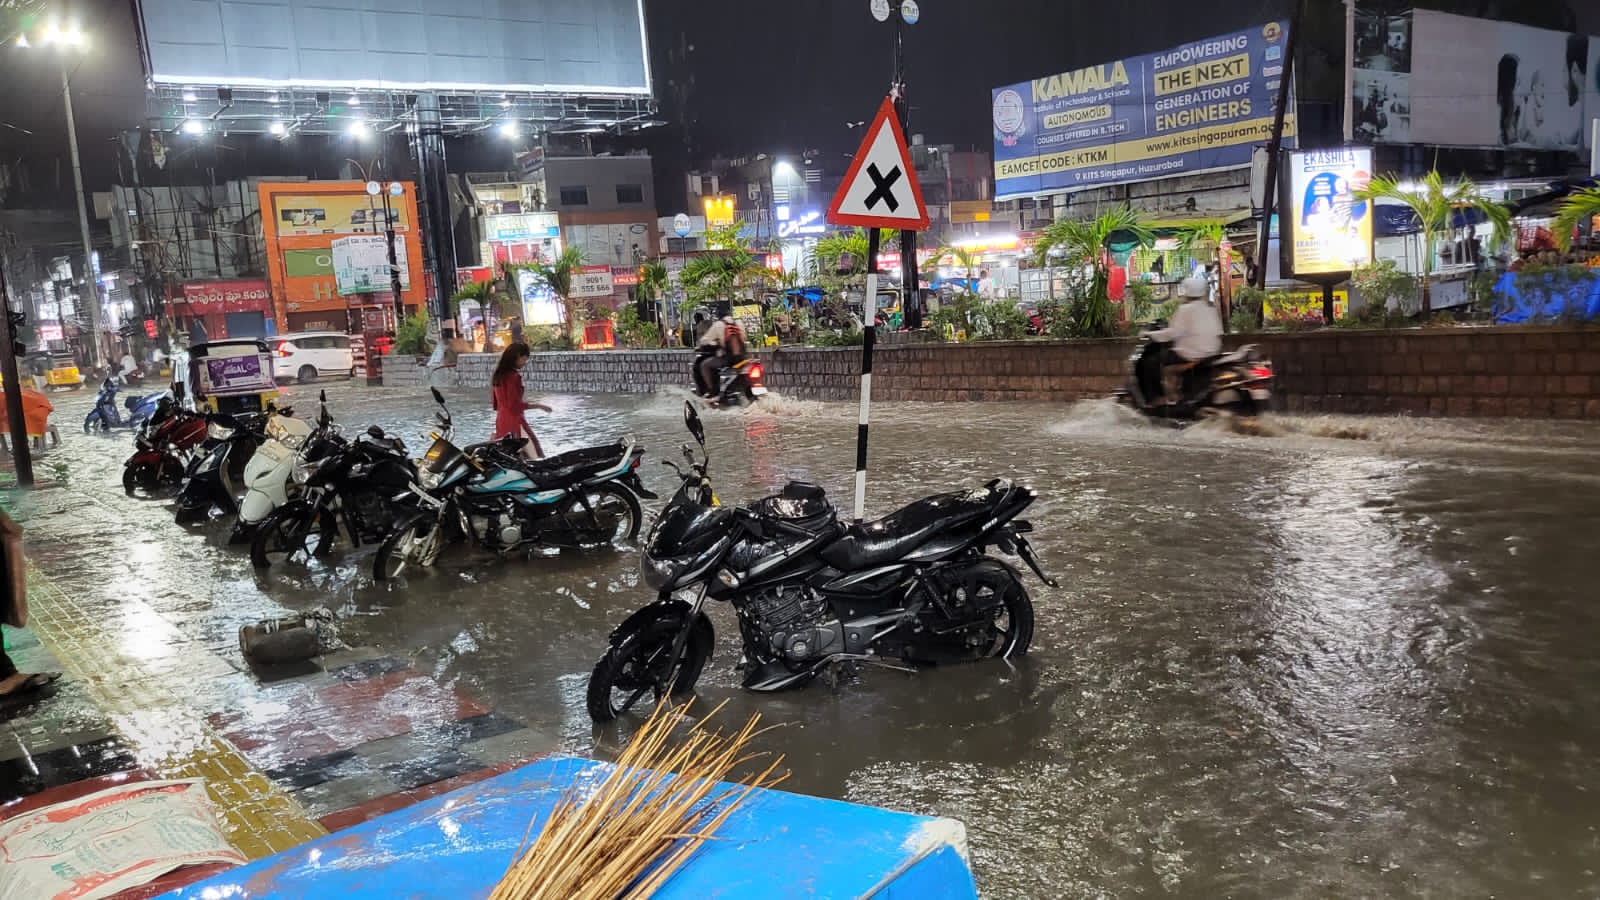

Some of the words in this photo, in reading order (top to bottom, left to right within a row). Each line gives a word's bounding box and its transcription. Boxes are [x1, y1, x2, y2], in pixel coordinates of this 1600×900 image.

[1153, 35, 1248, 69] EMPOWERING
[1031, 60, 1129, 103] KAMALA
[1159, 70, 1192, 91] THE
[1197, 58, 1244, 82] NEXT
[1155, 86, 1230, 111] GENERATION
[1233, 82, 1251, 96] OF
[1048, 106, 1107, 127] AUTONOMOUS
[1155, 98, 1251, 131] ENGINEERS
[1037, 134, 1063, 145] COURSES
[1064, 129, 1091, 142] OFFERED
[1091, 127, 1099, 136] IN
[1108, 122, 1125, 133] TECH
[1002, 160, 1040, 176] EAMCET
[1077, 150, 1108, 164] KTKM
[1082, 171, 1099, 180] KITS
[1100, 166, 1138, 179] Singapur,
[1138, 158, 1184, 174] Huzurabad
